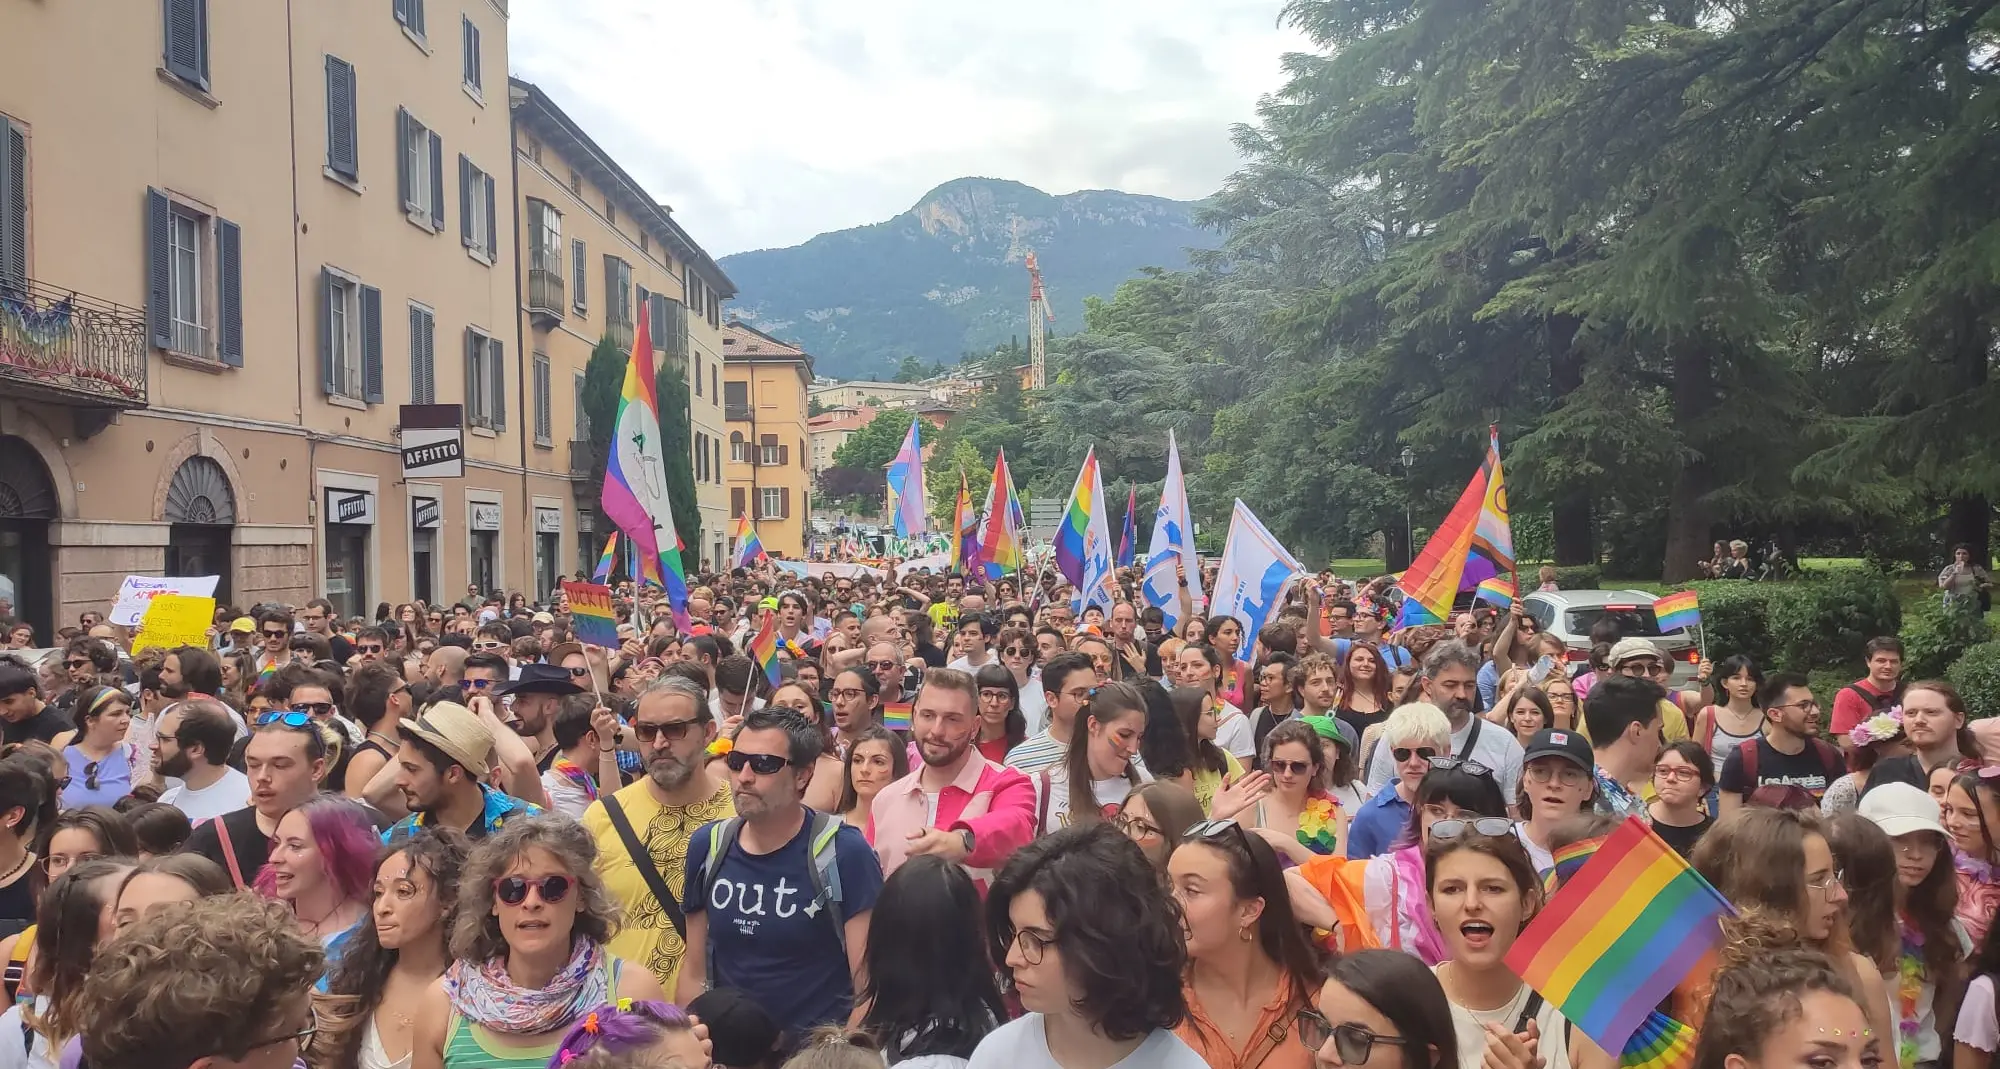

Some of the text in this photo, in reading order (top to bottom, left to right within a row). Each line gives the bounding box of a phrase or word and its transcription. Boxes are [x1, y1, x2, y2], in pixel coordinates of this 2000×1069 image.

[405, 442, 458, 466] AFFITTO
[339, 498, 365, 518] AFFITTO
[417, 504, 439, 524] AFFITTO
[1782, 774, 1826, 788] Angeles
[711, 876, 798, 918] out
